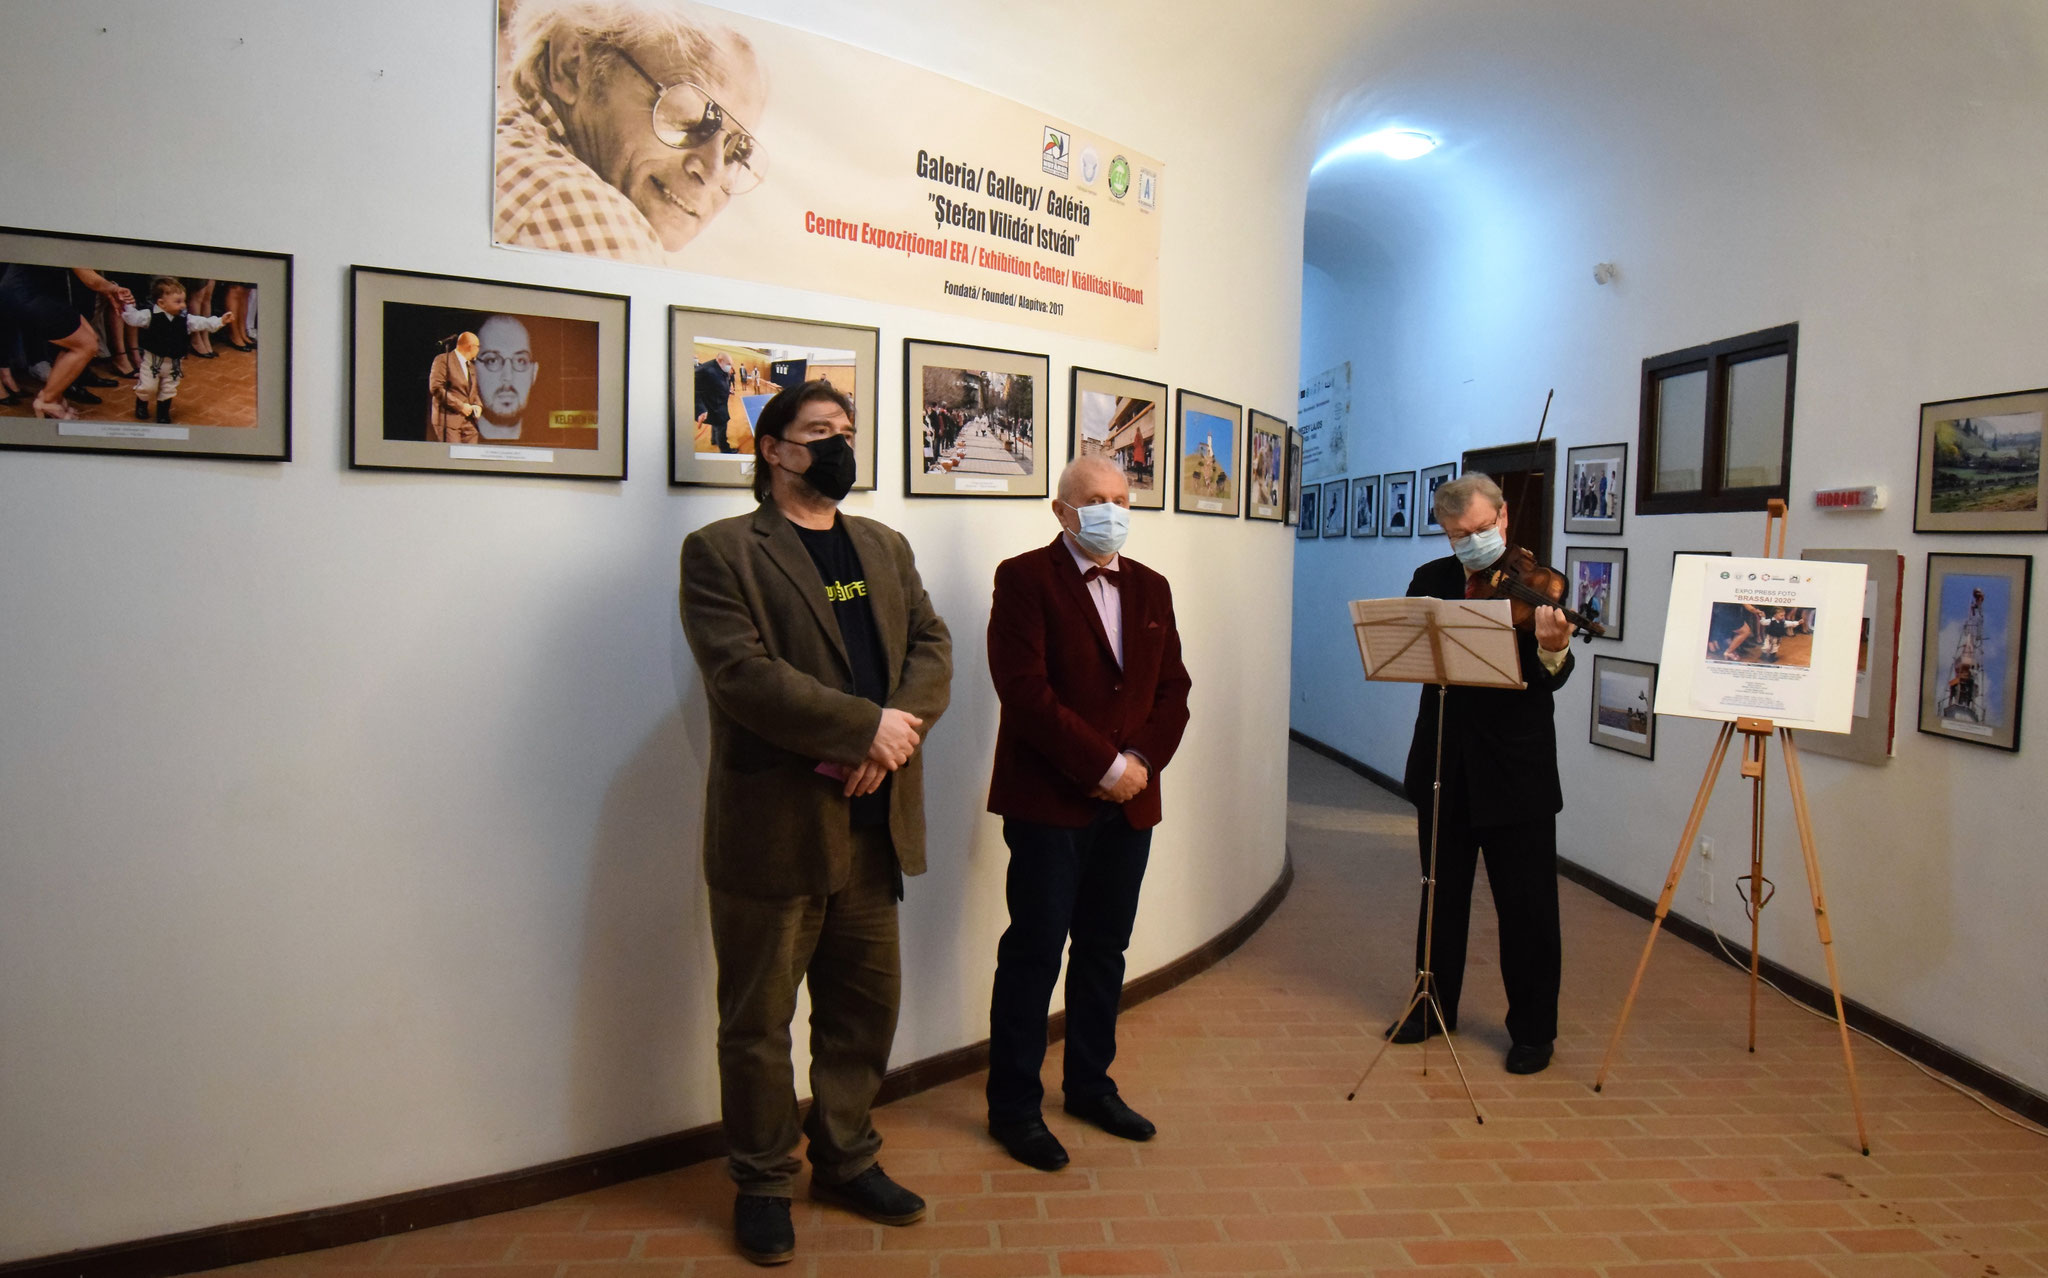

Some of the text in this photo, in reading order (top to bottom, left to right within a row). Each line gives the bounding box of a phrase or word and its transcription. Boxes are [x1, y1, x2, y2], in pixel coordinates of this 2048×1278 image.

[916, 149, 1090, 226] Galeria/ Gallery/ Galéria
[989, 209, 1034, 245] Vilidár
[805, 210, 858, 242] Centru
[861, 222, 947, 259] Expozițional
[950, 240, 969, 264] EFA
[979, 247, 1031, 278] Exhibition
[1033, 260, 1071, 287] Center/
[1072, 269, 1111, 297] Kiállítási
[1113, 280, 1144, 305] Központ
[982, 287, 1018, 308] Founded/
[1018, 295, 1049, 314] Alapítva:
[1049, 302, 1064, 316] 2017
[1816, 491, 1862, 506] HIDRANT
